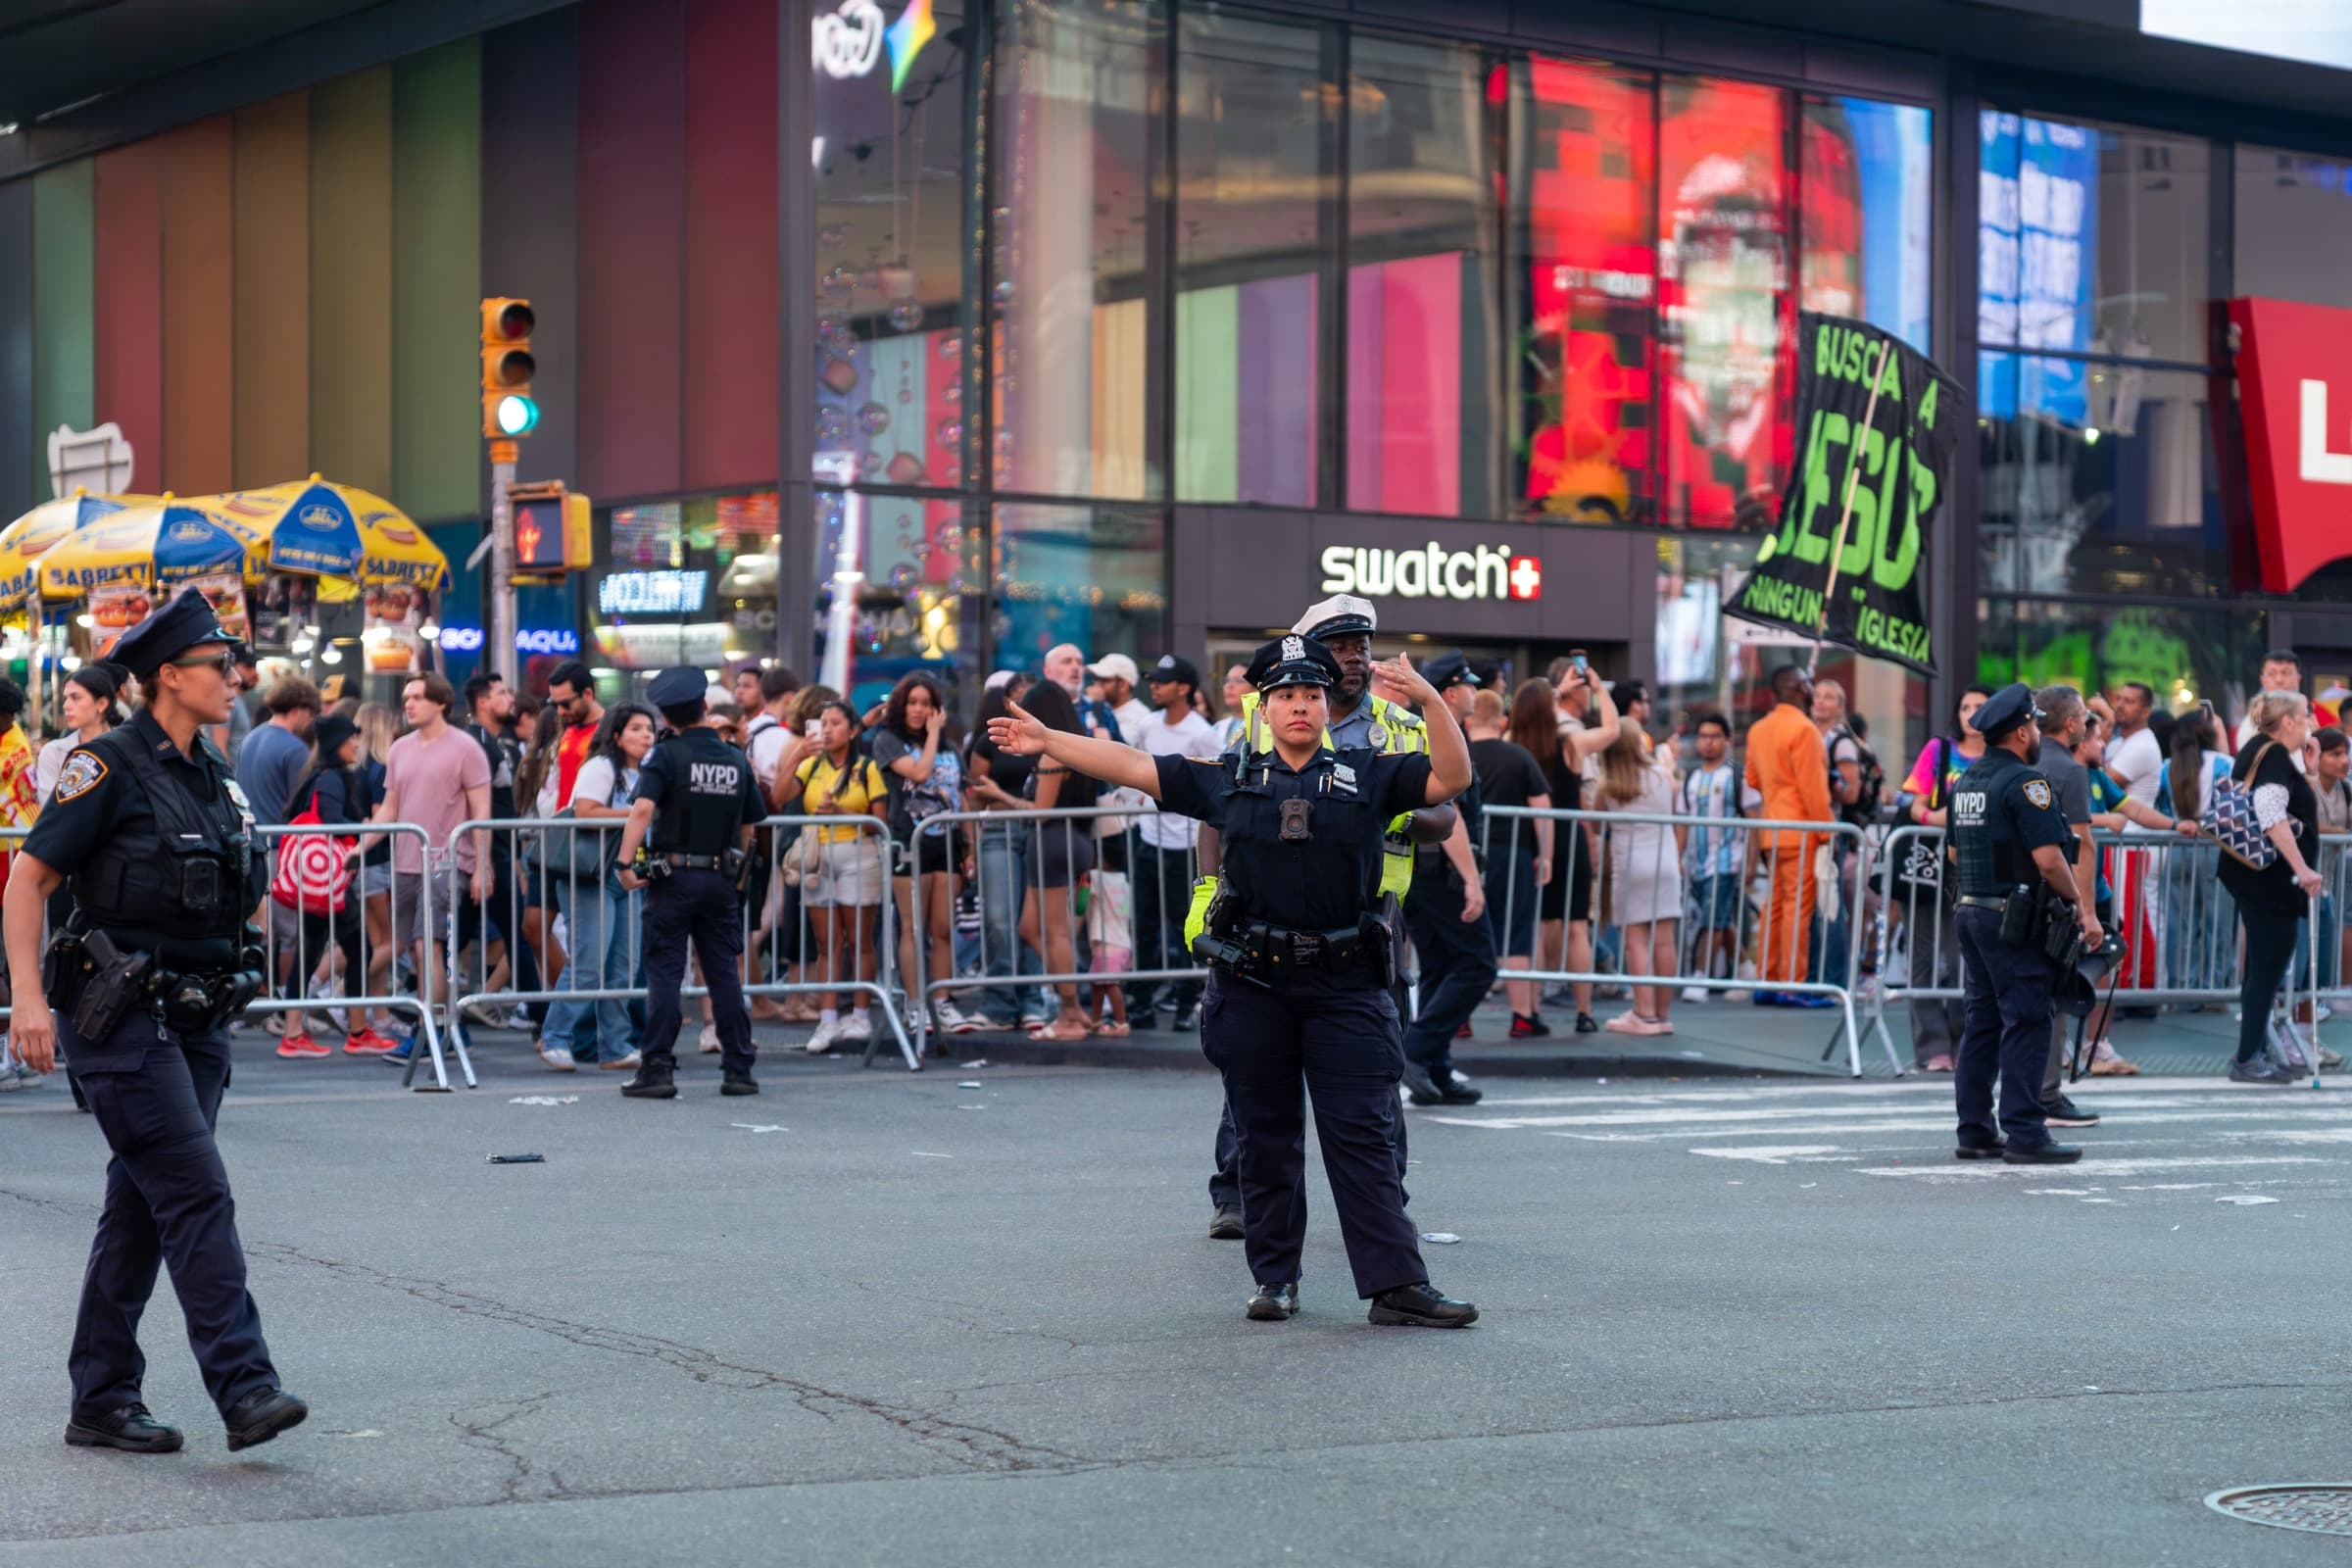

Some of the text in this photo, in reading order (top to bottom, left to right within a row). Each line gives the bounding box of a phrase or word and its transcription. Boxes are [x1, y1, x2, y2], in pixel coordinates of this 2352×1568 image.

[1816, 323, 1901, 402] BUSCA
[1918, 378, 1938, 431] A
[1322, 541, 1510, 600] swatch
[690, 762, 738, 786] NYPD
[1954, 791, 1986, 814] NYPD
